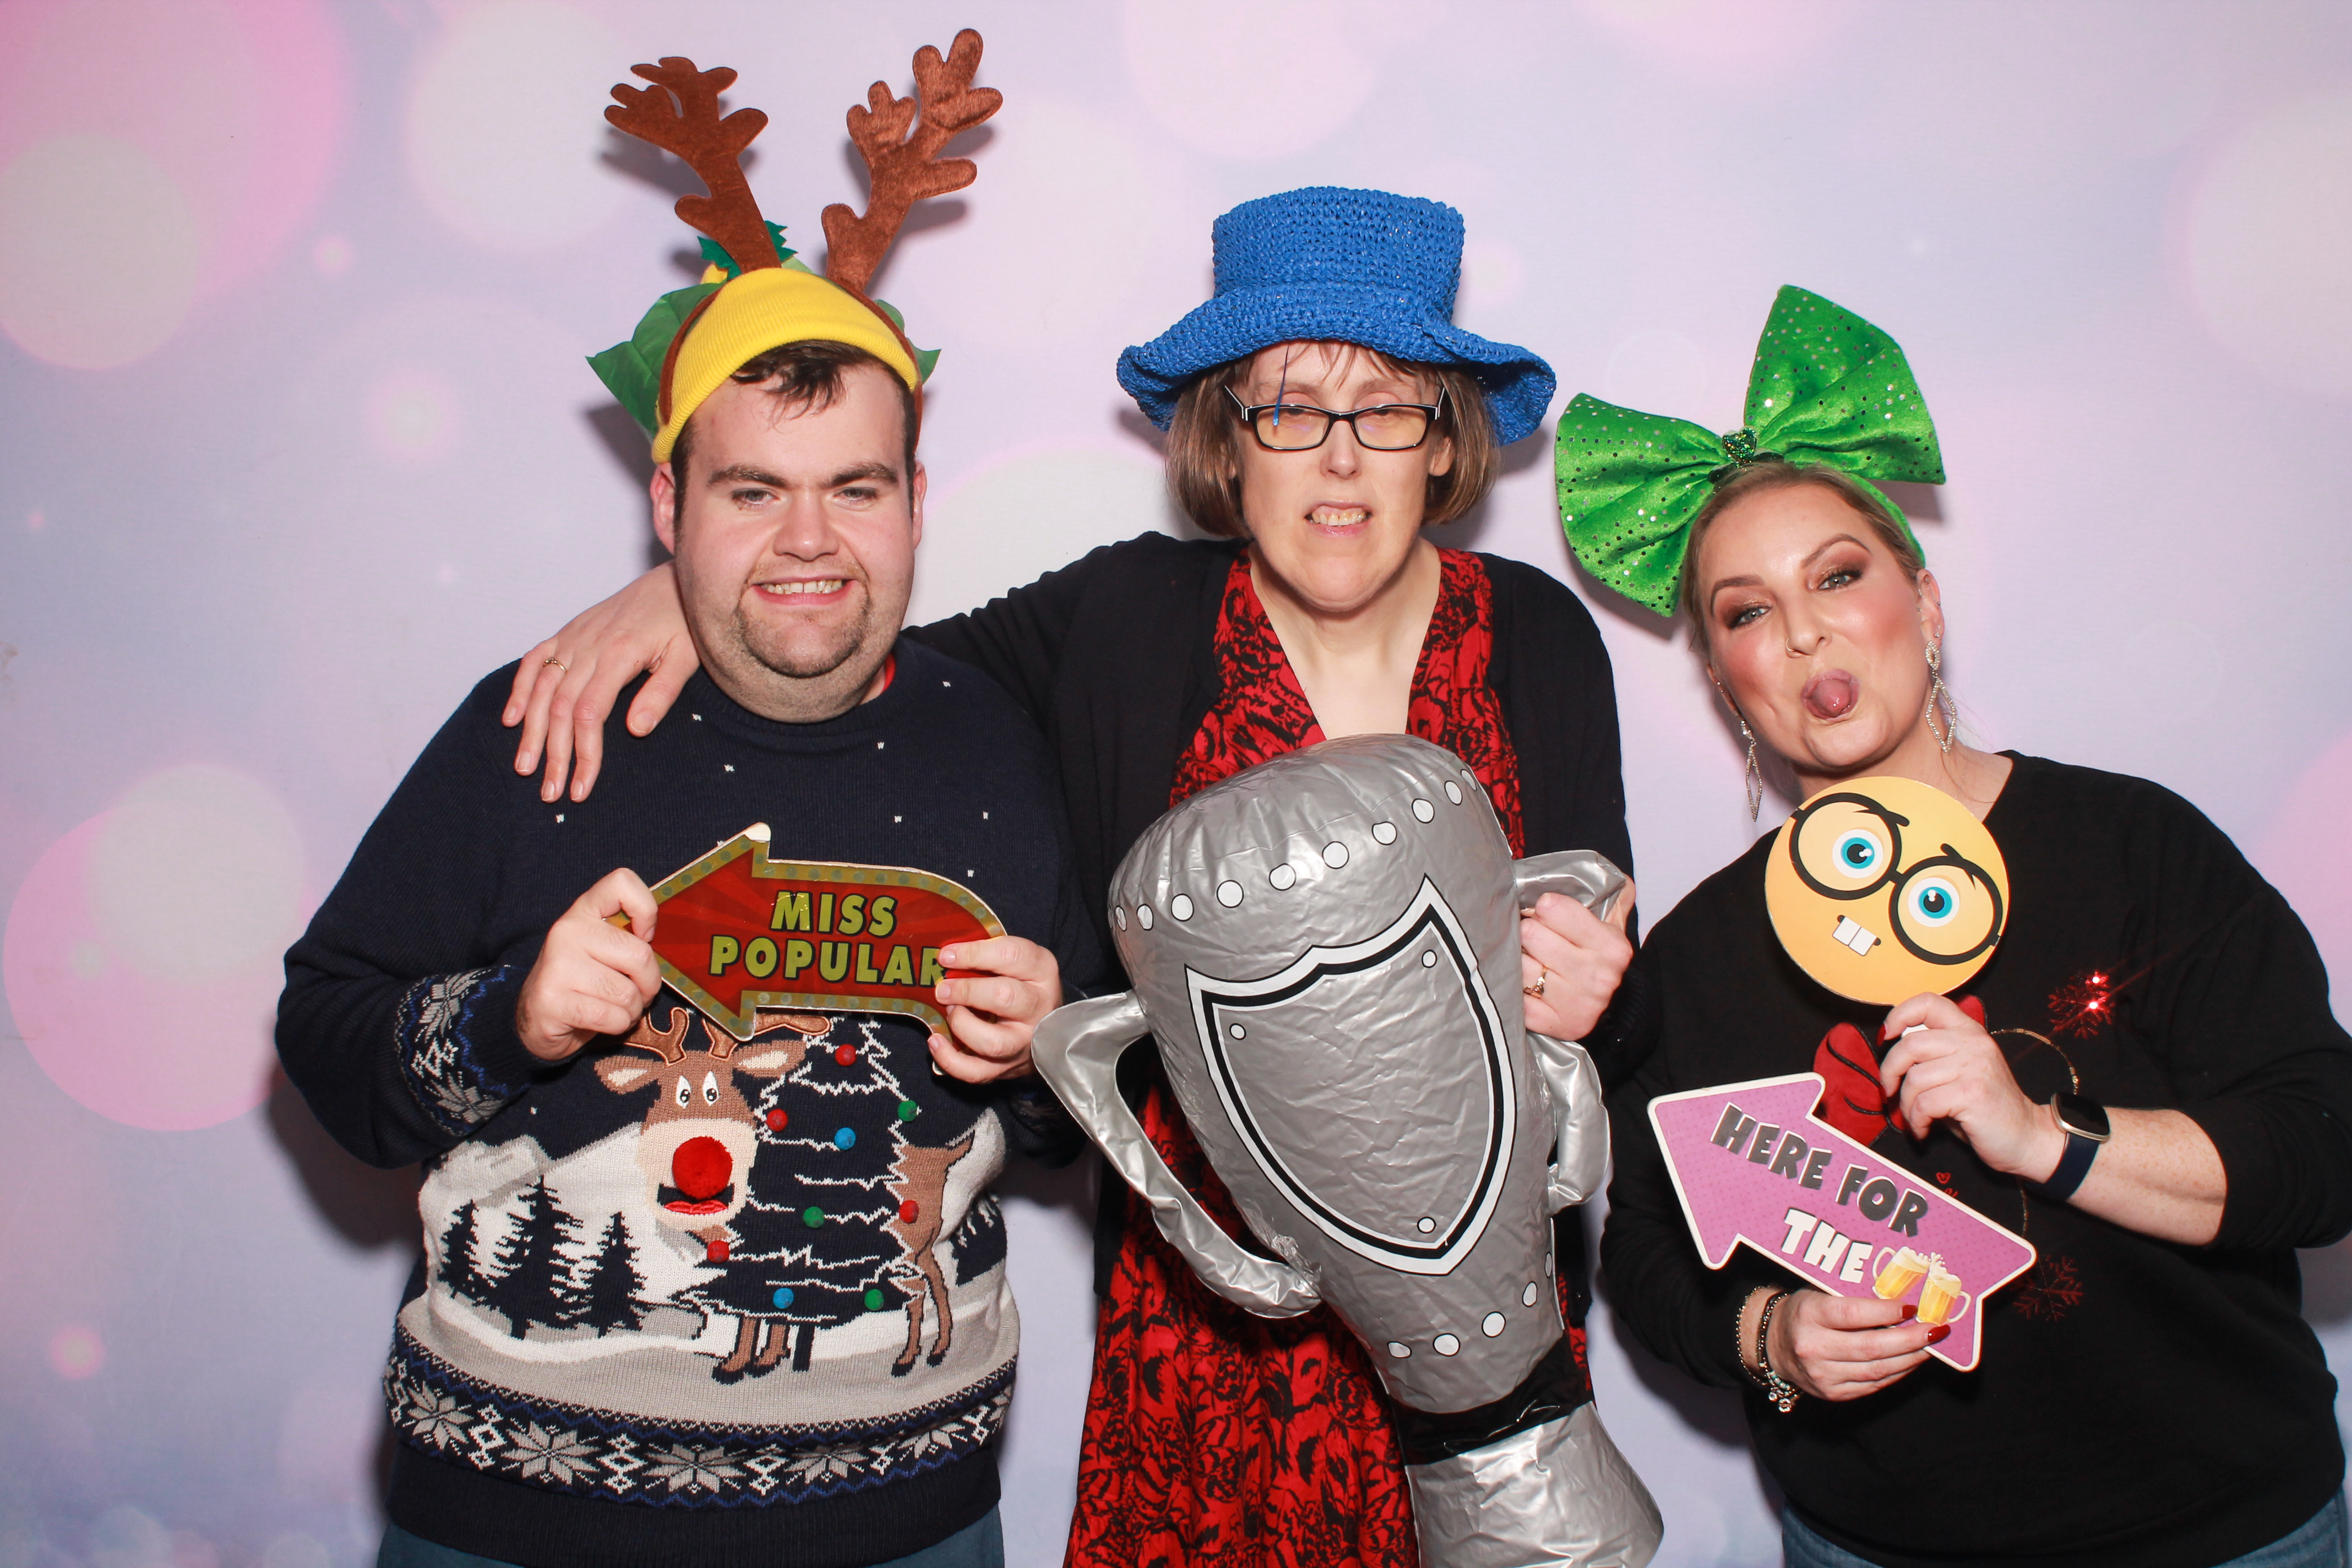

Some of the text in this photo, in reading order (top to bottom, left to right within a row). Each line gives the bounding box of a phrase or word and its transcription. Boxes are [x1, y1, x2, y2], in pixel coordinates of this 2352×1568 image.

[771, 890, 897, 937] MISS
[709, 935, 948, 986] POPULAR
[1710, 1102, 1928, 1237] HERE FOR
[1781, 1207, 1873, 1284] THE
